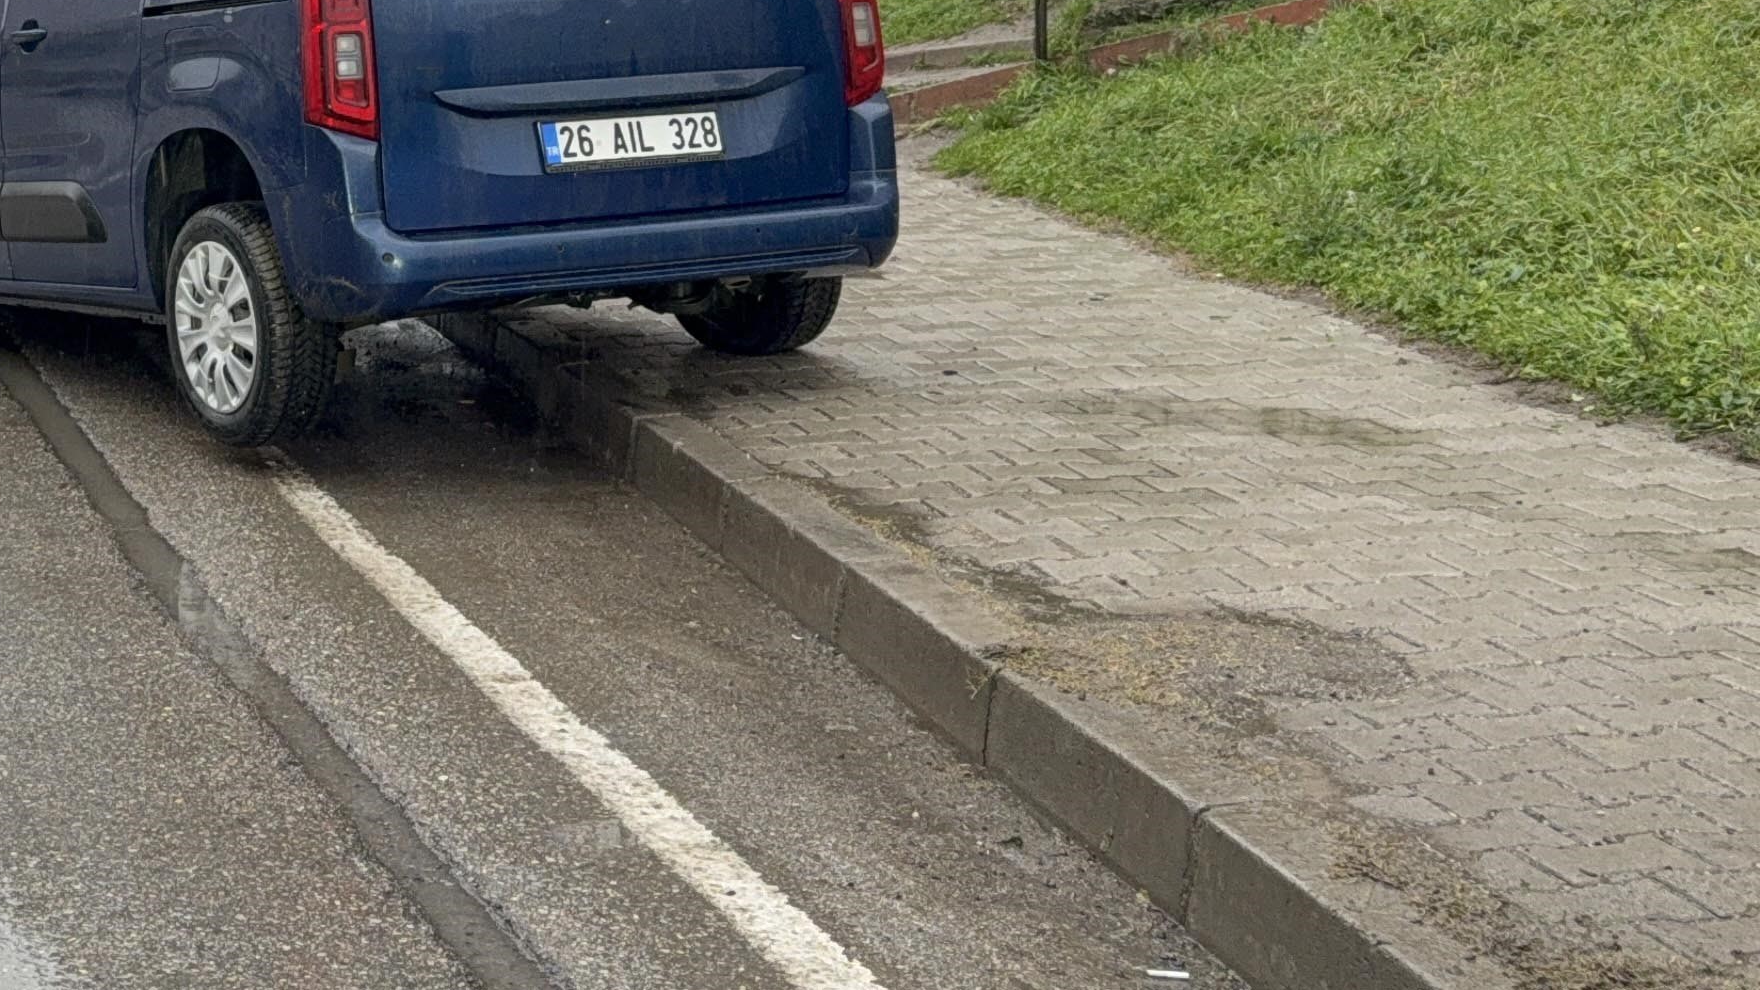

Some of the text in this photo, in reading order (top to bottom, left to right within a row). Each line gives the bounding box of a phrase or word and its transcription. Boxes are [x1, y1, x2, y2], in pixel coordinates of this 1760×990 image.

[559, 116, 718, 158] 26 AIL 328
[546, 146, 559, 156] TR
